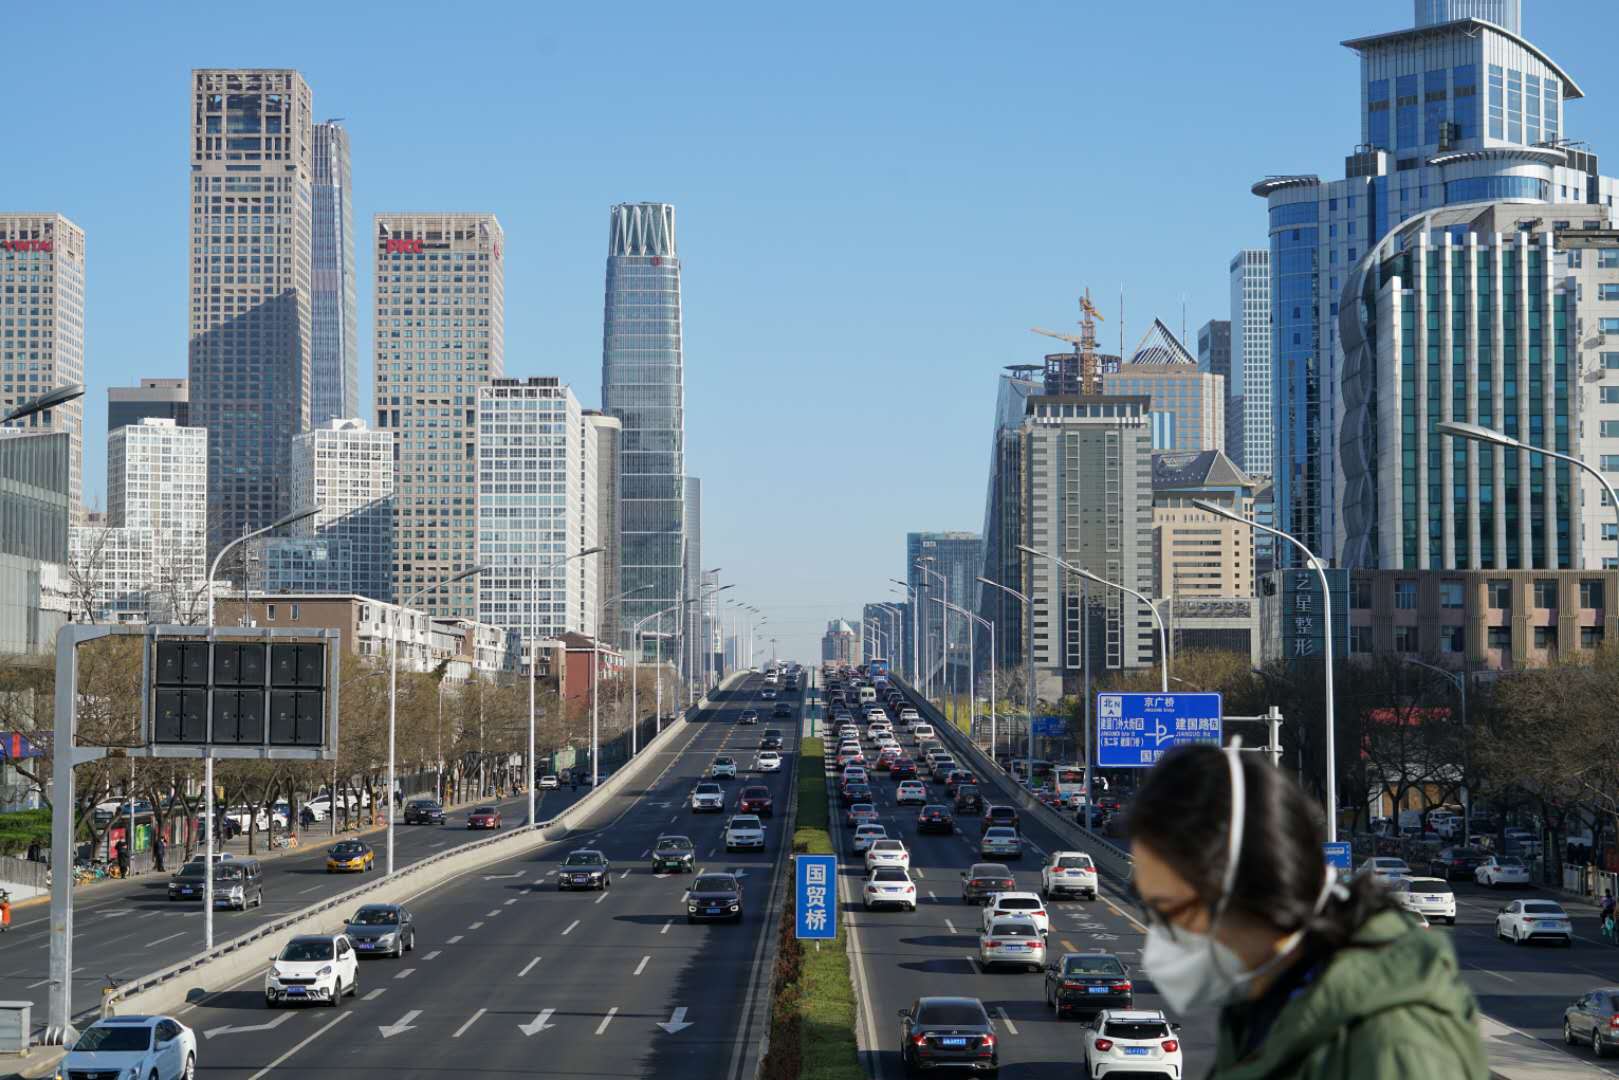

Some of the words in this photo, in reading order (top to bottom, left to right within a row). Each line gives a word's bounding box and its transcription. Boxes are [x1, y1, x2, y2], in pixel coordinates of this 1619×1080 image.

[1295, 572, 1313, 656] 艺星整形
[1144, 697, 1174, 708] 京广桥
[806, 864, 827, 931] 国贸桥
